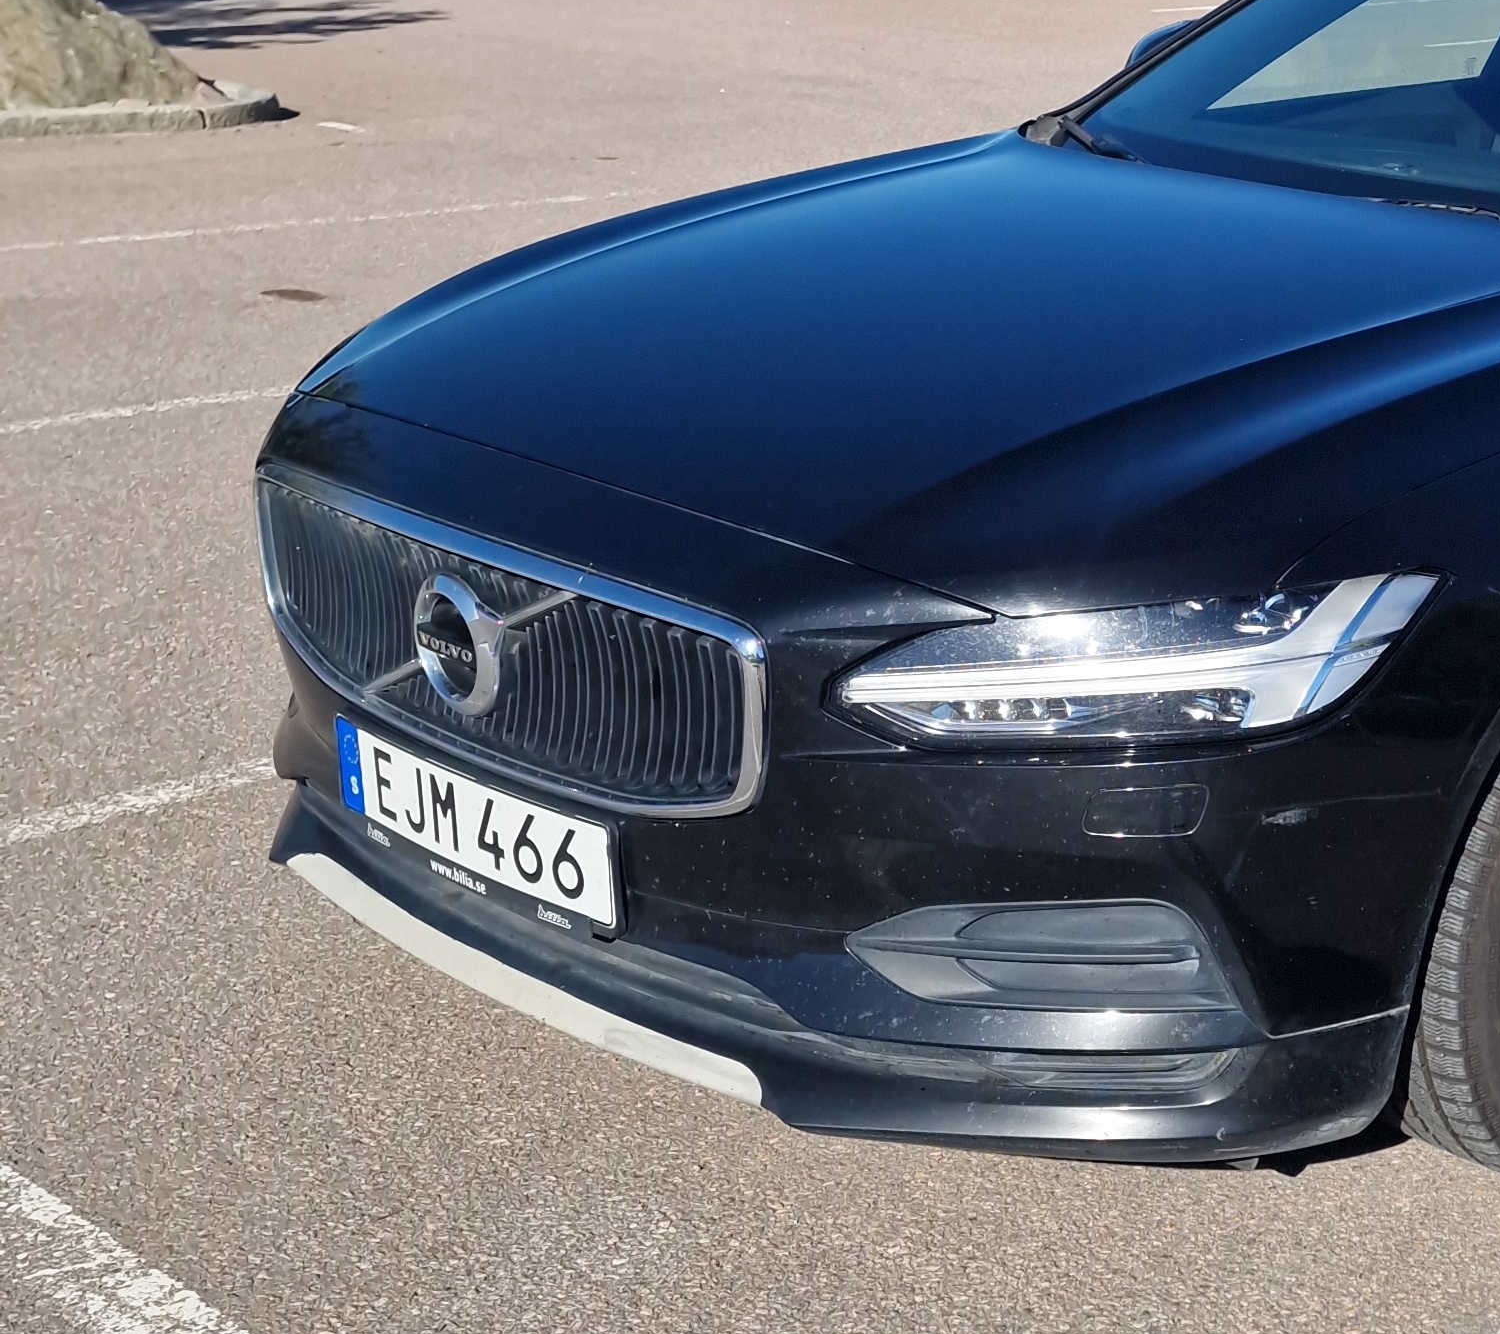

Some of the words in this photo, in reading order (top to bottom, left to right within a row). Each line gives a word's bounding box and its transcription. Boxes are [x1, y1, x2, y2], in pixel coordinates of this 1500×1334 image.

[418, 630, 473, 663] VOLVO
[350, 775, 360, 795] S
[373, 746, 460, 853] EJM
[477, 798, 585, 900] 466
[430, 859, 487, 896] www.bilia.se
